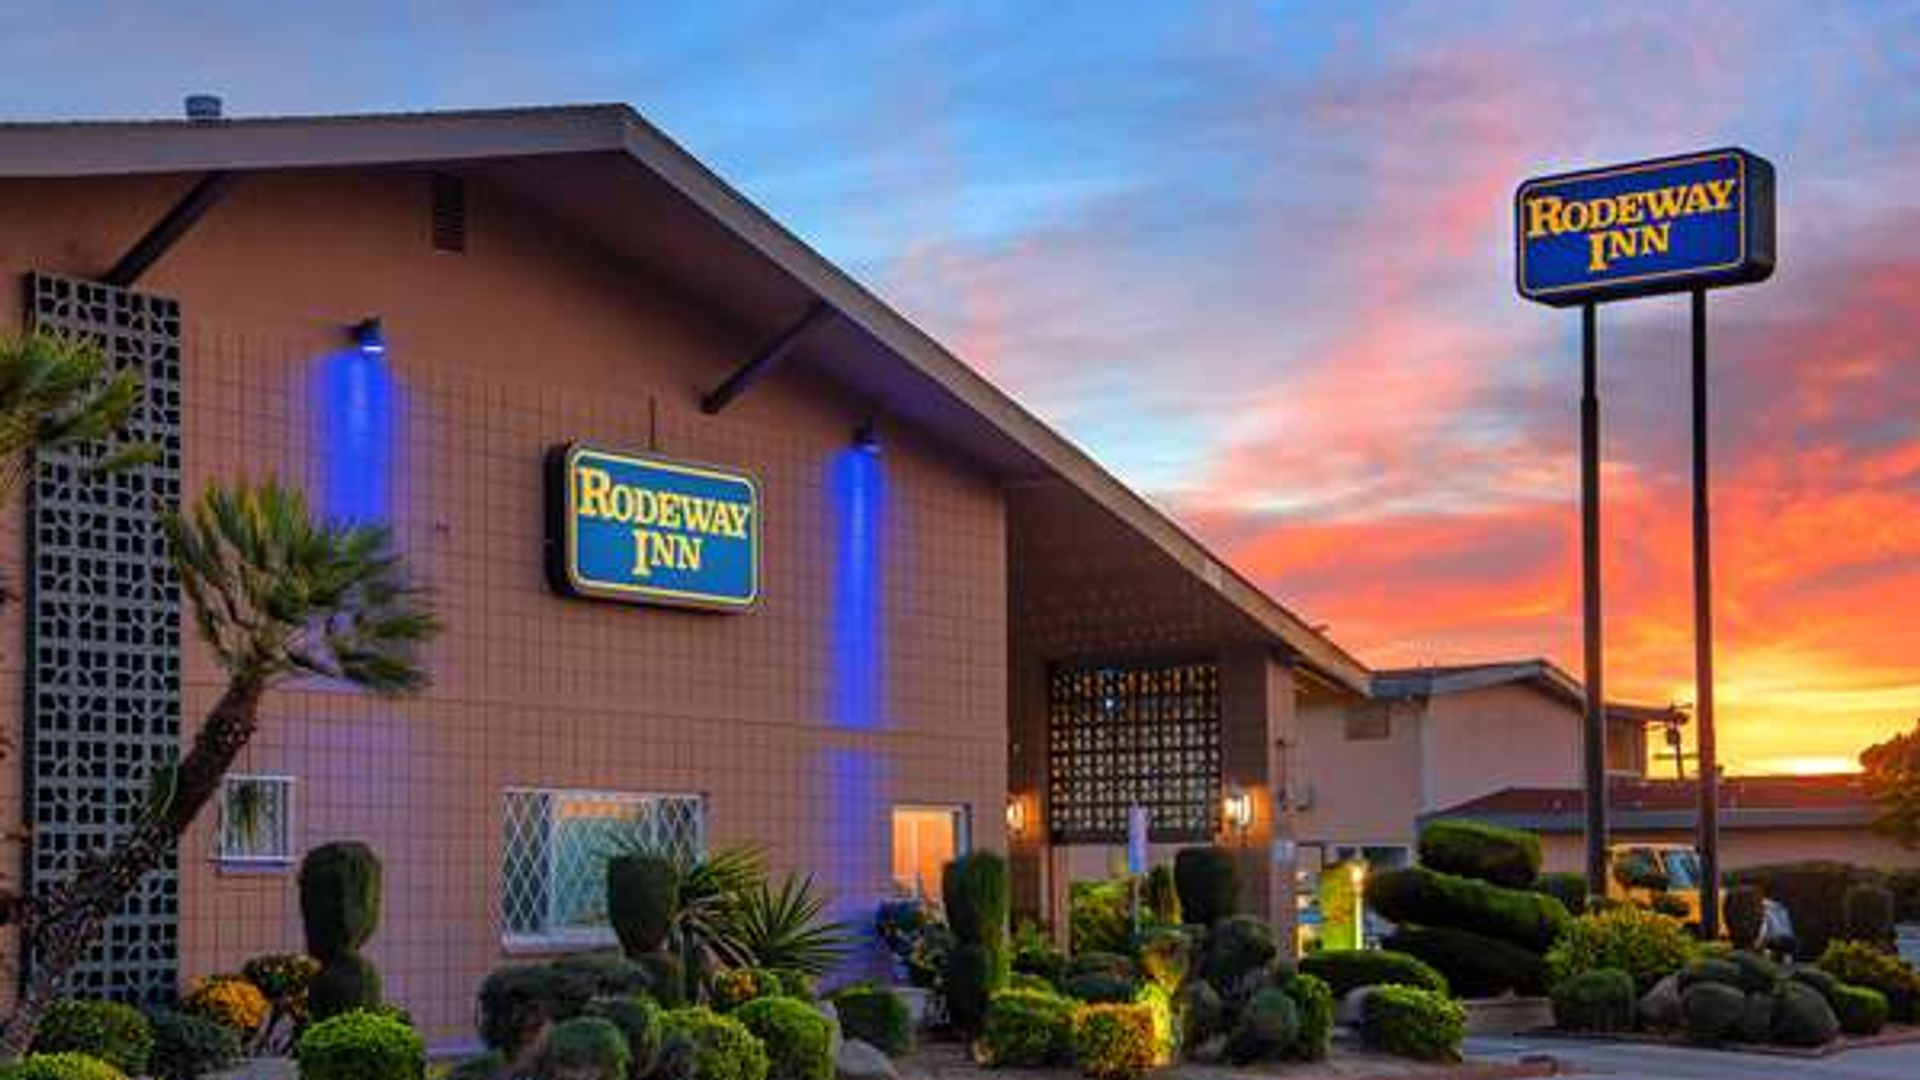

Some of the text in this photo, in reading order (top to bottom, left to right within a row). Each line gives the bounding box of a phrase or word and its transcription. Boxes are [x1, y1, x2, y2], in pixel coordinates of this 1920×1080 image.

[1526, 179, 1735, 238] RODEWAY
[1588, 222, 1671, 271] INN
[577, 466, 749, 539] RODEWAY
[632, 529, 702, 576] INN
